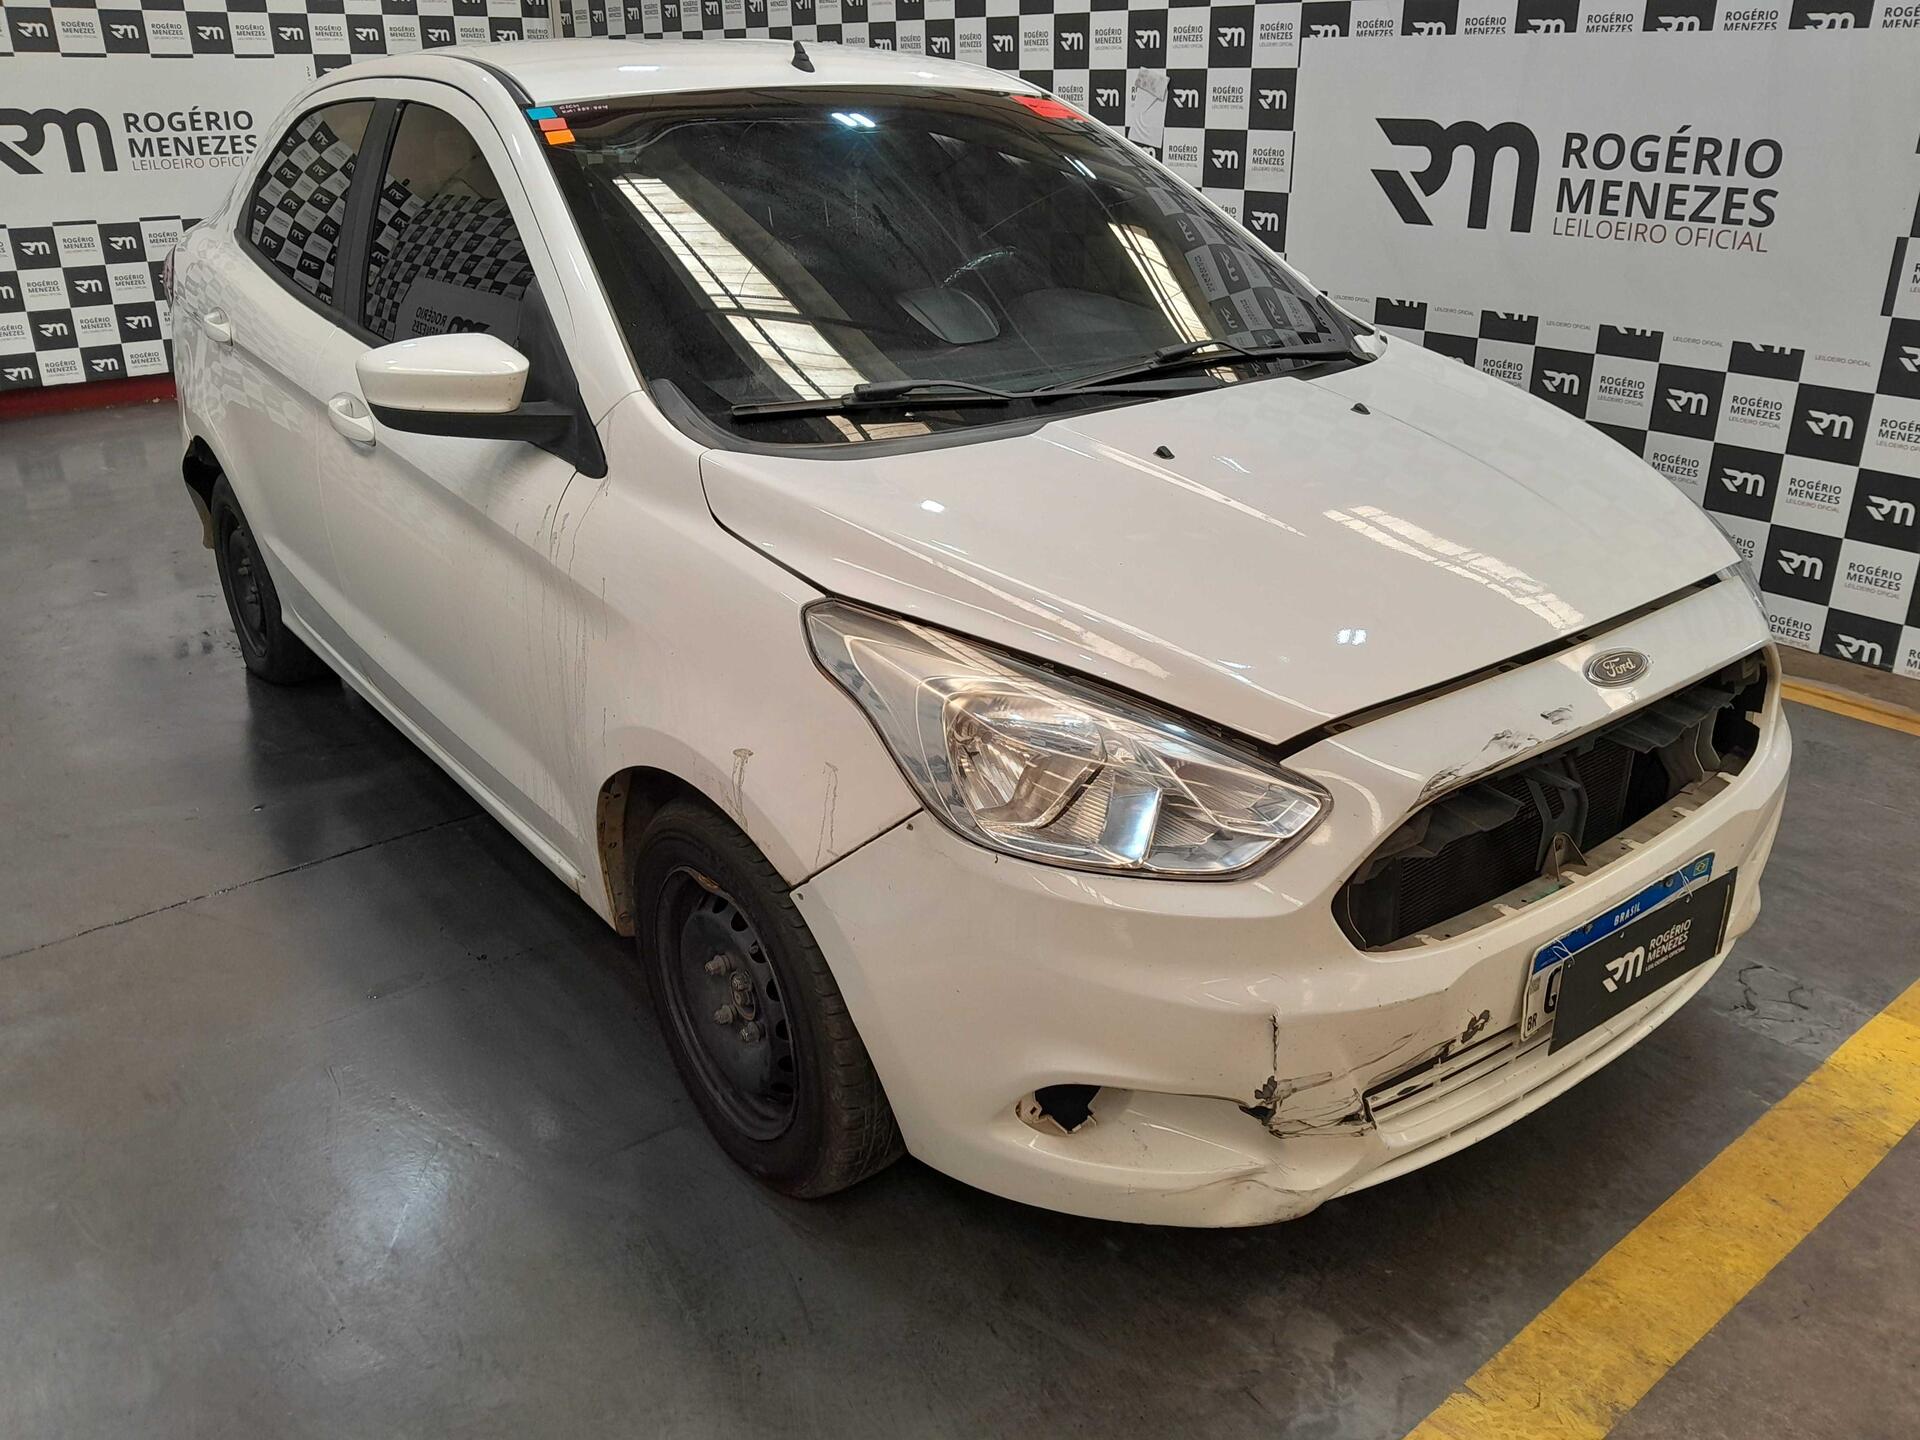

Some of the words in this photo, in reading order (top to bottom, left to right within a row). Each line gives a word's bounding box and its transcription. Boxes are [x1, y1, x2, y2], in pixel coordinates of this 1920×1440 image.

[1725, 8, 1779, 21] ROGÉRIO
[1884, 4, 1920, 17] ROGÉ
[1356, 18, 1394, 30] ROGÉRIO
[1465, 15, 1507, 27] ROGÉRIO
[1587, 12, 1634, 24] ROGÉRIO
[1881, 19, 1920, 29] MENE
[1094, 27, 1122, 37] ROGÉRIO
[1173, 24, 1203, 34] ROGÉRIO
[1260, 21, 1293, 32] ROGÉRIO
[959, 32, 981, 41] ROGÉRIO
[1024, 30, 1049, 39] ROGÉRIO
[1094, 36, 1122, 44] MENEZES
[1172, 33, 1203, 43] MENEZES
[1259, 31, 1293, 41] MENEZES
[959, 40, 982, 48] MENEZES
[1058, 84, 1083, 94] ROGÉRIO
[1212, 84, 1243, 95] ROGÉRIO
[1212, 94, 1243, 104] MENEZES
[123, 106, 253, 133] ROGÉRIO
[128, 134, 258, 158] MENEZES
[1168, 143, 1198, 154] ROGÉRIO
[1252, 147, 1285, 158] ROGÉRIO
[1561, 124, 1783, 179] ROGÉRIO
[132, 156, 204, 171] LEILOEIRO
[208, 155, 249, 168] OFICI
[1168, 153, 1198, 162] MENEZES
[1252, 156, 1285, 167] MENEZES
[1555, 177, 1779, 229] MENEZES
[62, 236, 94, 244] ROGÉRIO
[1552, 217, 1667, 245] LEILOEIRO
[1675, 225, 1769, 253] OFICIAL
[63, 242, 96, 250] MENEZES
[0, 324, 23, 332] GÉRIO
[0, 330, 25, 338] ENEZES
[1483, 358, 1523, 371] ROGÉRIO
[1600, 375, 1645, 390] ROGÉRIO
[1599, 385, 1644, 400] MENEZES
[1732, 395, 1783, 411] ROGÉRIO
[1730, 405, 1781, 421] MENEZES
[1880, 418, 1920, 432] ROGÉR
[1878, 428, 1920, 444] MENEZ
[1653, 452, 1699, 468] ROGÉRIO
[1652, 462, 1698, 478] MENEZES
[1789, 477, 1842, 495] ROGÉRIO
[1787, 487, 1841, 505] MENEZES
[1849, 562, 1903, 581] ROGÉRIO
[1846, 572, 1901, 591] MENEZES
[1770, 614, 1812, 631] OGÉRIO
[1770, 624, 1811, 641] ENEZES
[1603, 657, 1636, 677] Ford
[1613, 902, 1640, 926] BRASIL
[1649, 919, 1691, 950] ROGÉRIO
[1646, 931, 1689, 963] MENEZES
[1527, 1012, 1538, 1031] BR
